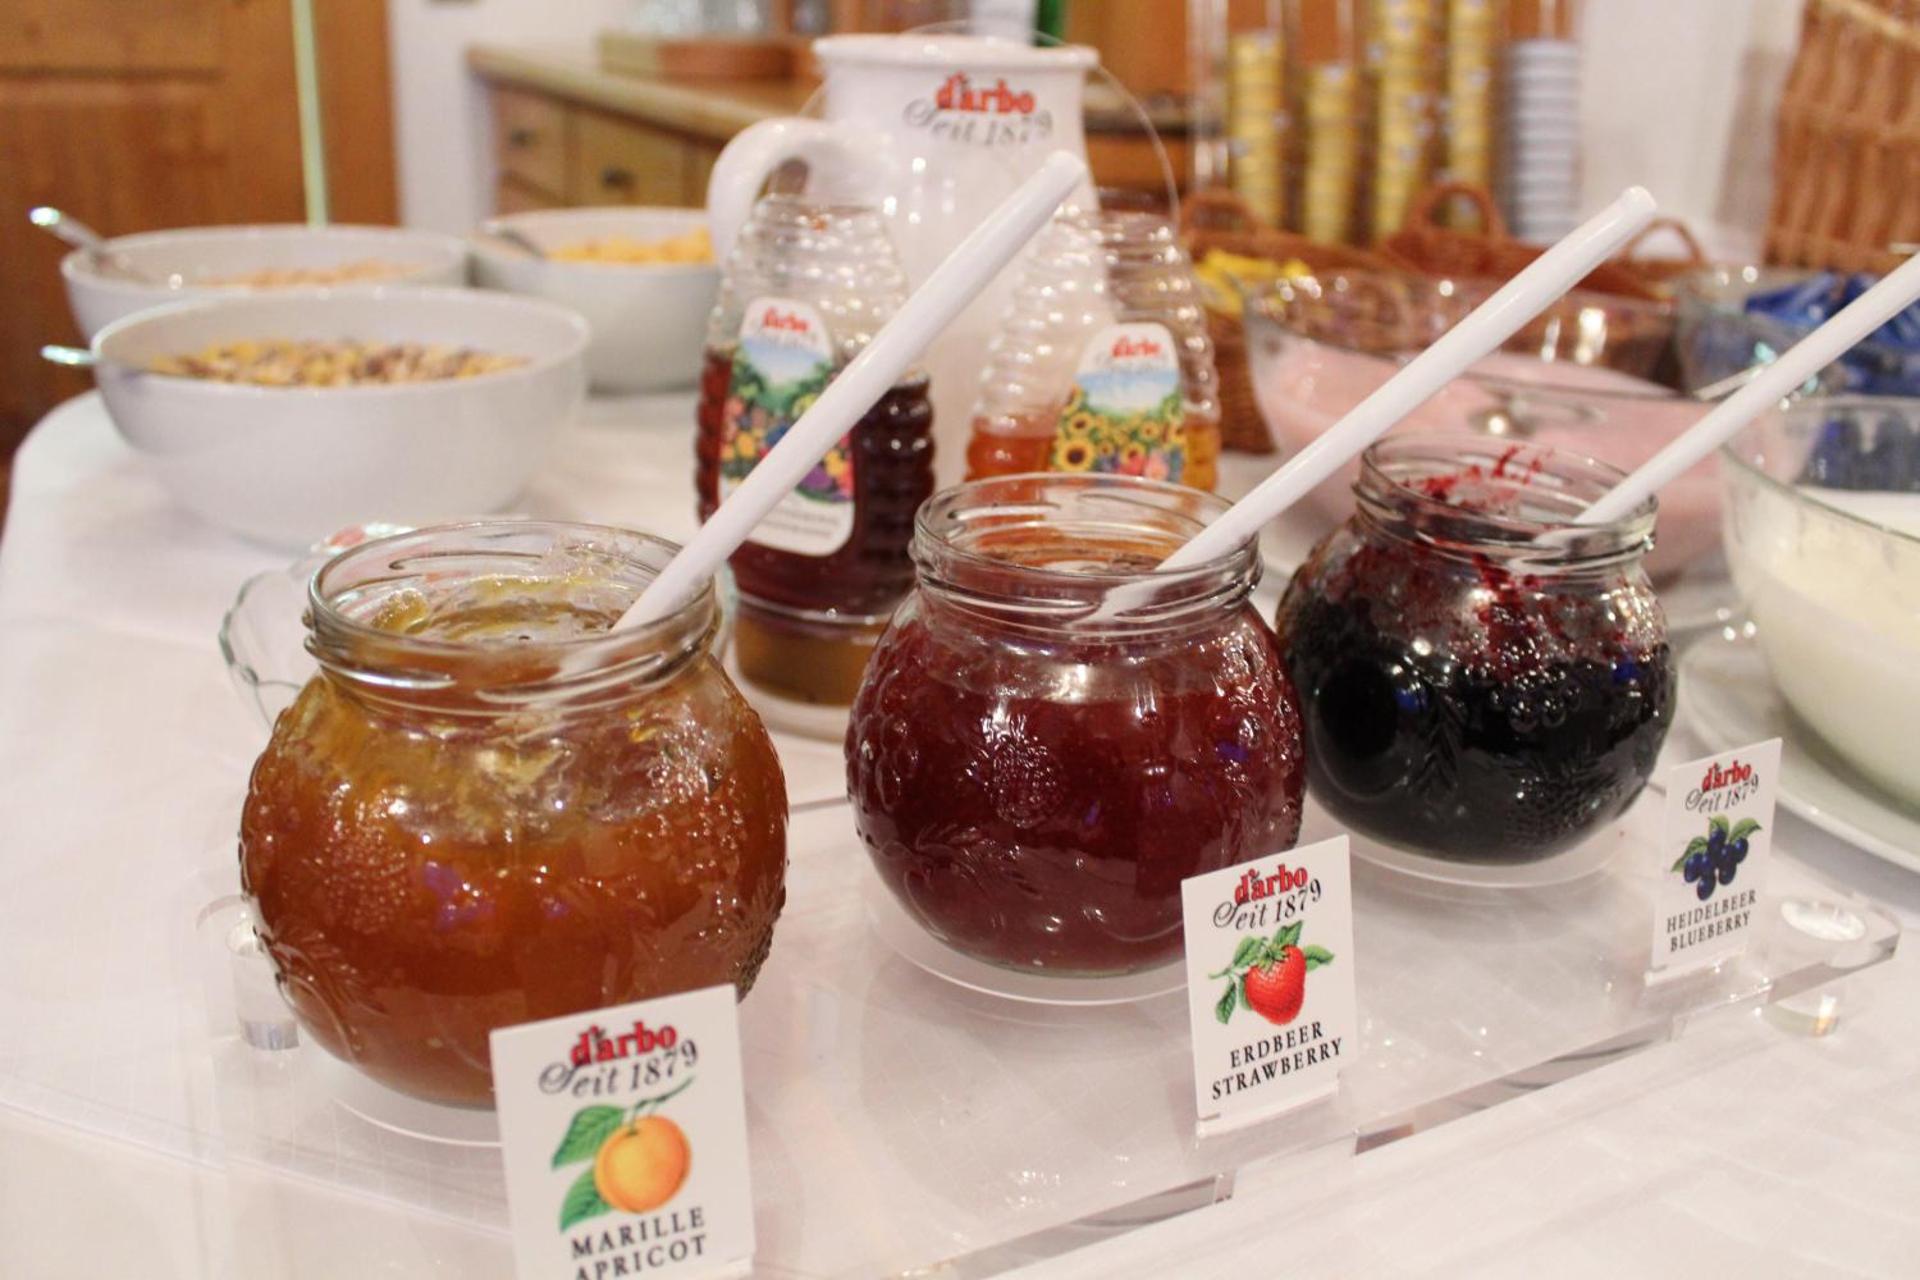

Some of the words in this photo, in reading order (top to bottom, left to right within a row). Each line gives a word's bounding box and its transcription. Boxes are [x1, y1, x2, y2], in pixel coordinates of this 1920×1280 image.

[1685, 786, 1721, 814] Seit
[1724, 774, 1760, 809] 1879
[1213, 901, 1267, 931] Seit
[1274, 878, 1322, 923] 1879
[1234, 863, 1309, 907] d'arbo
[1666, 889, 1757, 934] HEIDELBEER
[1669, 911, 1751, 953] BLUEBERRY
[570, 1021, 678, 1068] d'arbo
[1230, 1021, 1324, 1069] ERDBEER
[538, 1061, 619, 1098] Seit
[629, 1039, 698, 1092] 1879
[1211, 1037, 1343, 1101] STRAWBERRY
[571, 1206, 706, 1260] MARILLE
[576, 1234, 707, 1280] APRICOT
